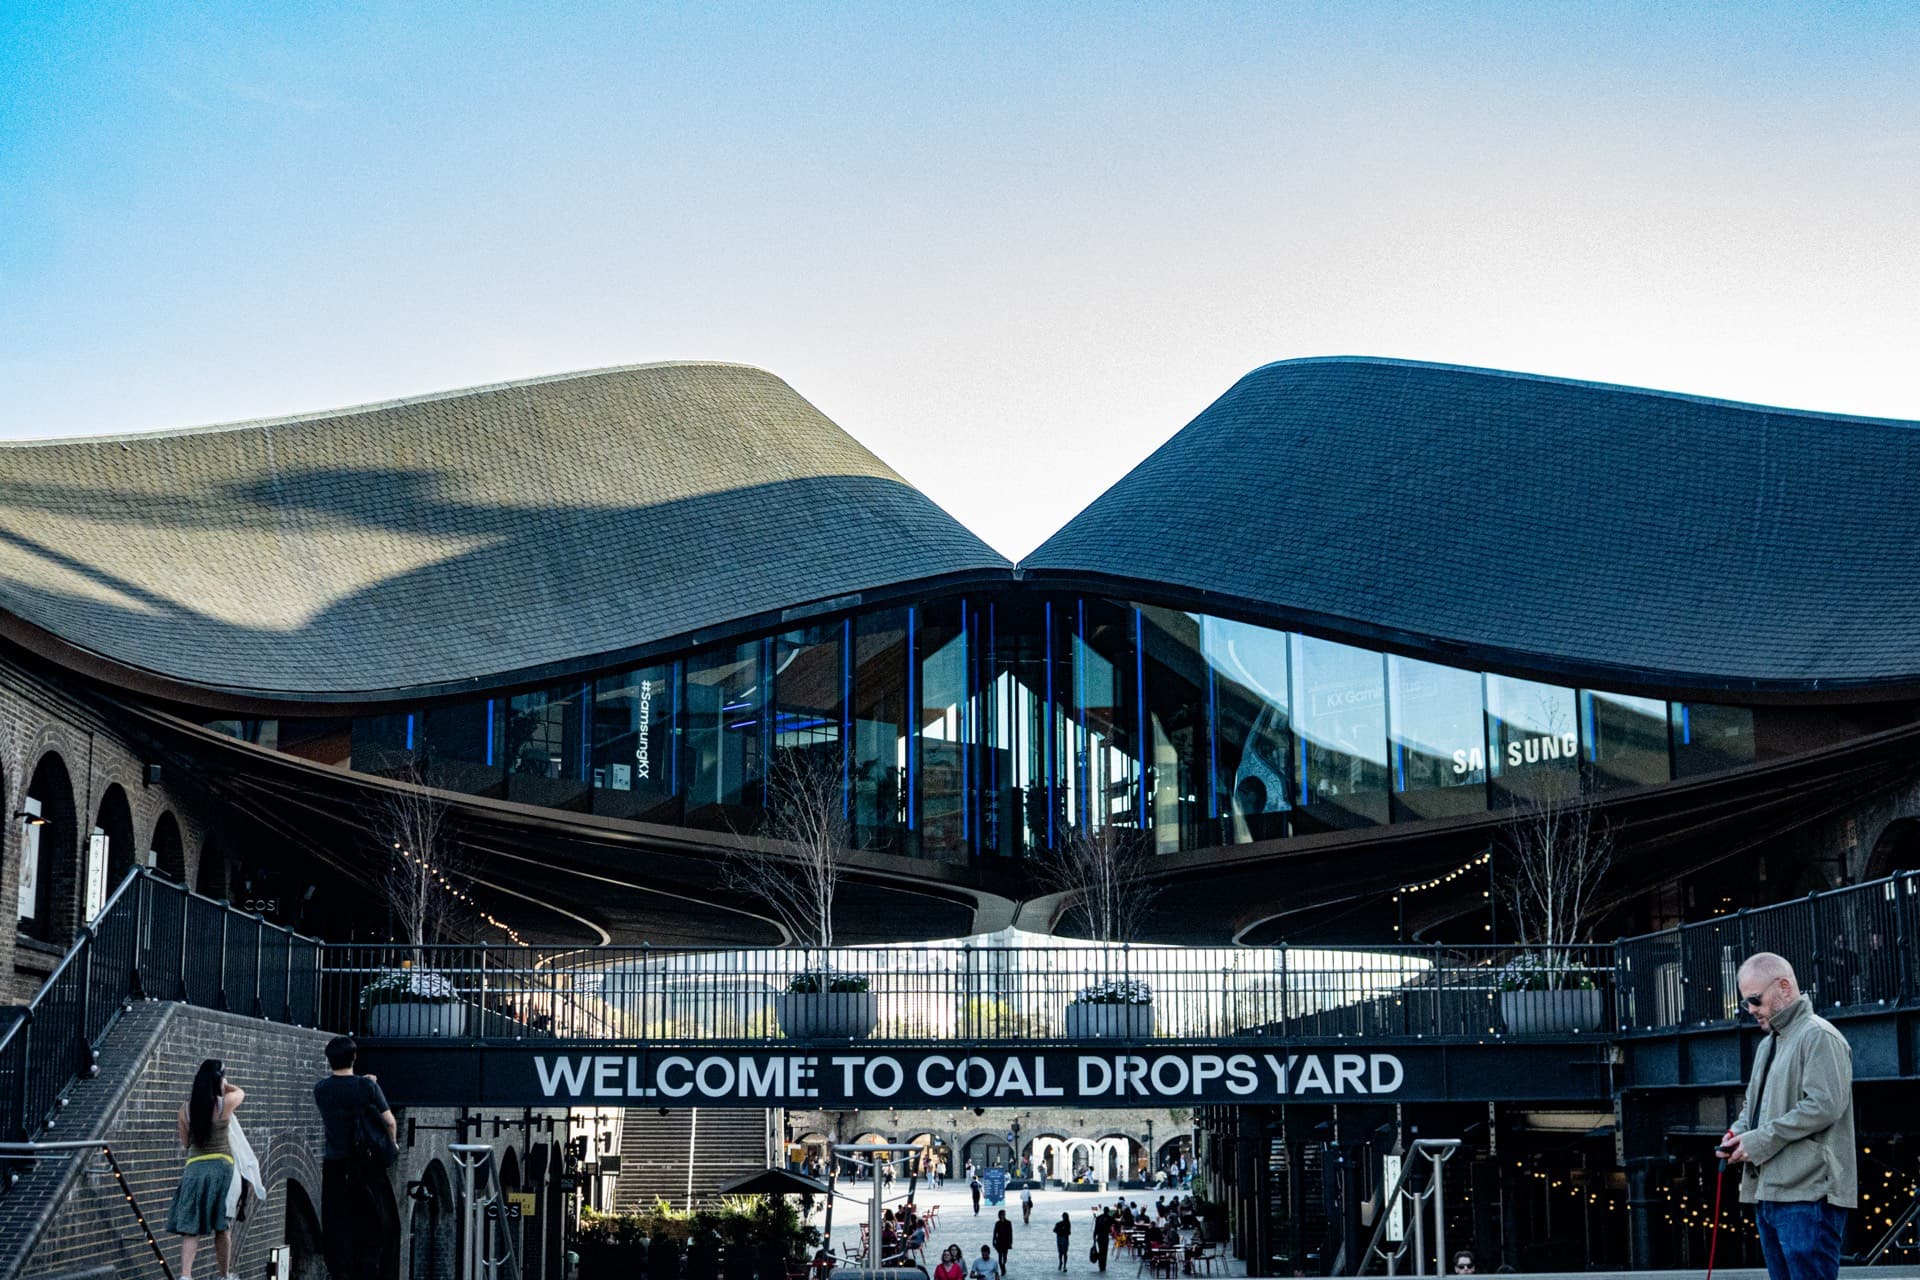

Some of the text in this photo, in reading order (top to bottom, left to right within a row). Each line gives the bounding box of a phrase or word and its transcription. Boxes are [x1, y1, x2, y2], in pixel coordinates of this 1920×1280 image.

[636, 680, 651, 779] #SamsungKX
[244, 899, 276, 911] COS
[535, 1055, 1404, 1097] WELCOME TO COAL DROPS YARD
